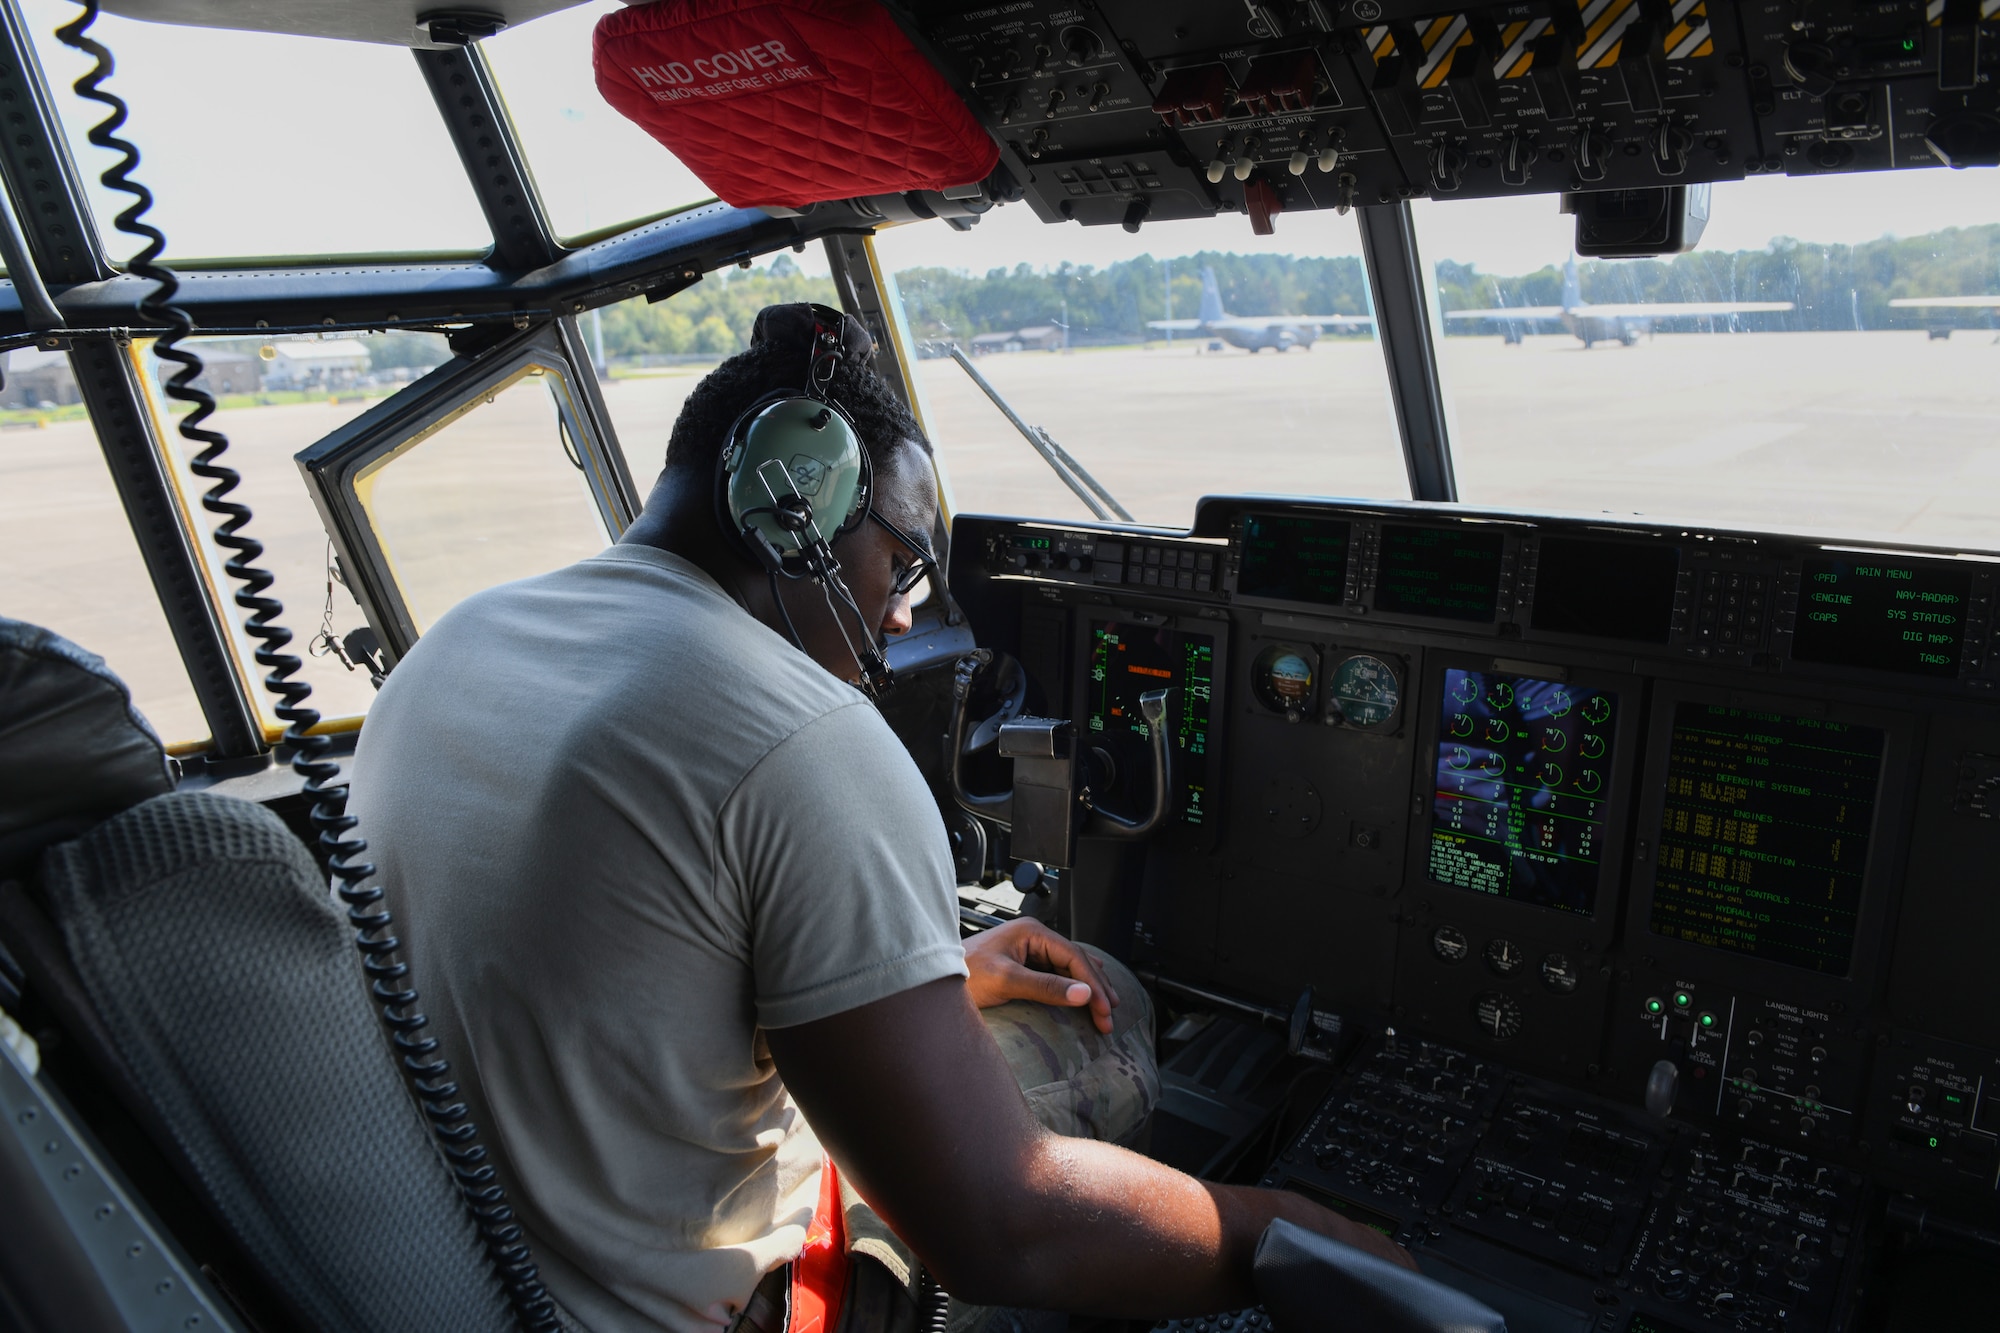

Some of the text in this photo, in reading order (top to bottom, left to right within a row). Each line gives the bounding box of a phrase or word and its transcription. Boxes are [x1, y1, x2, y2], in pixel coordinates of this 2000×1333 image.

[963, 1, 1034, 21] EXTERIOR LIGHTING
[1360, 9, 1376, 17] ENG
[1508, 6, 1530, 15] FIRE
[1879, 5, 1899, 13] EGT
[1049, 10, 1078, 20] COVERT/
[990, 21, 1024, 32] NAVIGATION
[1049, 15, 1084, 27] FORMATION
[1001, 27, 1024, 36] LIGHTS
[1826, 24, 1853, 33] START
[1764, 32, 1784, 41] STOP
[1219, 50, 1246, 60] FADEC
[631, 40, 796, 87] HUD COVER
[650, 66, 814, 102] REMOVE BEFORE FLIGHT
[1782, 91, 1802, 100] ELT
[1107, 98, 1132, 106] STROBE
[1056, 105, 1079, 113] BOTTOM
[1228, 115, 1315, 132] PROPELLER CONTROL
[1855, 566, 1913, 580] MAIN MENU
[1887, 609, 1907, 620] SYS
[1903, 631, 1923, 641] DIG
[1708, 706, 1781, 723] ECB BY SYSTEM
[1797, 718, 1849, 732] OPEN ONLY
[1744, 734, 1784, 745] AIRDROP
[1746, 756, 1769, 766] BIUS
[1716, 773, 1811, 796] DEFENSIVE SYSTEMS
[1733, 809, 1773, 823] ENGINES
[1713, 844, 1796, 867] FIRE PROTECTION
[1430, 857, 1454, 866] MISSION
[1484, 868, 1504, 878] INSTLD
[1471, 860, 1501, 871] IMBALANCE
[1476, 873, 1497, 881] INSTLD
[1708, 881, 1790, 904] FLIGHT CONTROLS
[1716, 905, 1771, 922] HYDRAULICS
[1712, 926, 1756, 941] LIGHTING
[1676, 980, 1695, 990] GEAR
[1674, 1008, 1690, 1016] NOSE
[1765, 1000, 1829, 1021] LANDING LIGHTS
[1779, 1013, 1803, 1024] MOTORS
[1706, 1030, 1722, 1038] RIGHT
[1778, 1033, 1798, 1043] EXTEND
[1774, 1048, 1797, 1057] RETRACT
[1689, 1054, 1716, 1066] RELEASE
[1927, 1057, 1955, 1069] BRAKES
[1772, 1065, 1794, 1075] LIGHTS
[1914, 1066, 1930, 1074] ANTI
[1912, 1072, 1928, 1080] SKID
[1948, 1074, 1967, 1083] EMER
[1935, 1078, 1958, 1087] BRAKE
[1745, 1092, 1766, 1102] LIGHTS
[1575, 1110, 1599, 1120] RADAR
[1791, 1105, 1829, 1120] TAXI LIGHTS
[1900, 1116, 1930, 1128] AUX PSI
[1944, 1119, 1963, 1128] PUMP
[1297, 1115, 1322, 1148] CONTROL
[1740, 1138, 1808, 1161] COPILOT LIGHTING
[1688, 1176, 1702, 1184] TEST
[1552, 1182, 1566, 1190] GAIN
[1583, 1192, 1612, 1205] FUNCTION
[1798, 1216, 1826, 1228] MASTER
[1799, 1211, 1827, 1223] DISPLAY
[1630, 1230, 1650, 1271] CONTROL
[1788, 1280, 1810, 1292] RADIO
